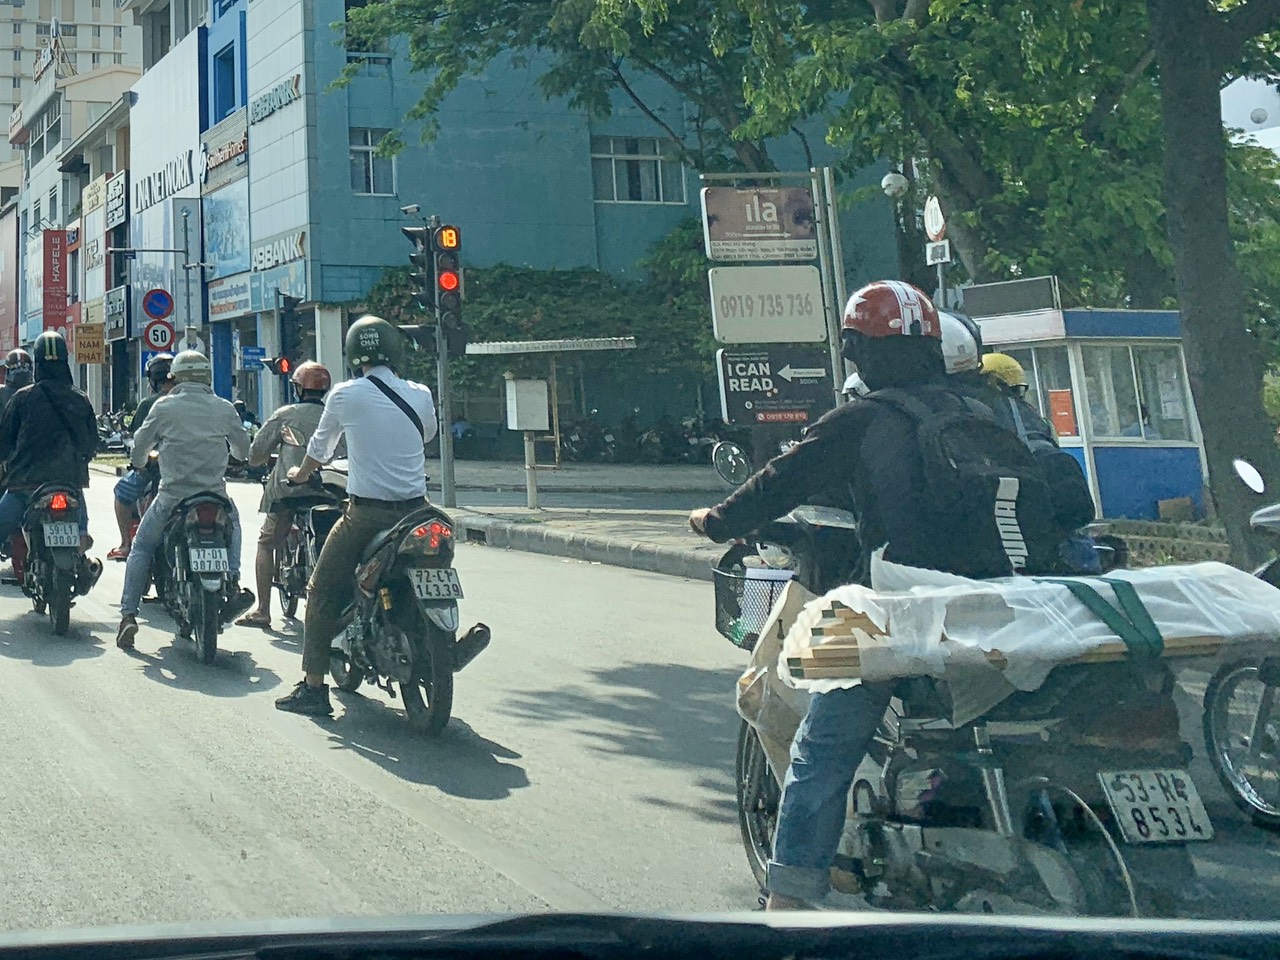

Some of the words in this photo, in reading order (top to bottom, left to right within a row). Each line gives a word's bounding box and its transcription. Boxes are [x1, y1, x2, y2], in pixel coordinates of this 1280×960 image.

[151, 150, 194, 207] NETWORK
[745, 194, 778, 223] ila
[442, 229, 457, 248] 18
[251, 232, 302, 273] ABBANK
[720, 294, 754, 319] 0919
[758, 293, 784, 318] 735
[786, 292, 813, 317] 736
[152, 329, 168, 343] 50
[79, 340, 101, 350] NAM
[727, 363, 733, 376] I
[735, 362, 771, 377] CAN
[49, 524, 73, 535] 59-L1
[416, 570, 453, 583] 72-C1
[416, 583, 461, 597] 143.39
[1131, 806, 1204, 839] 8534
